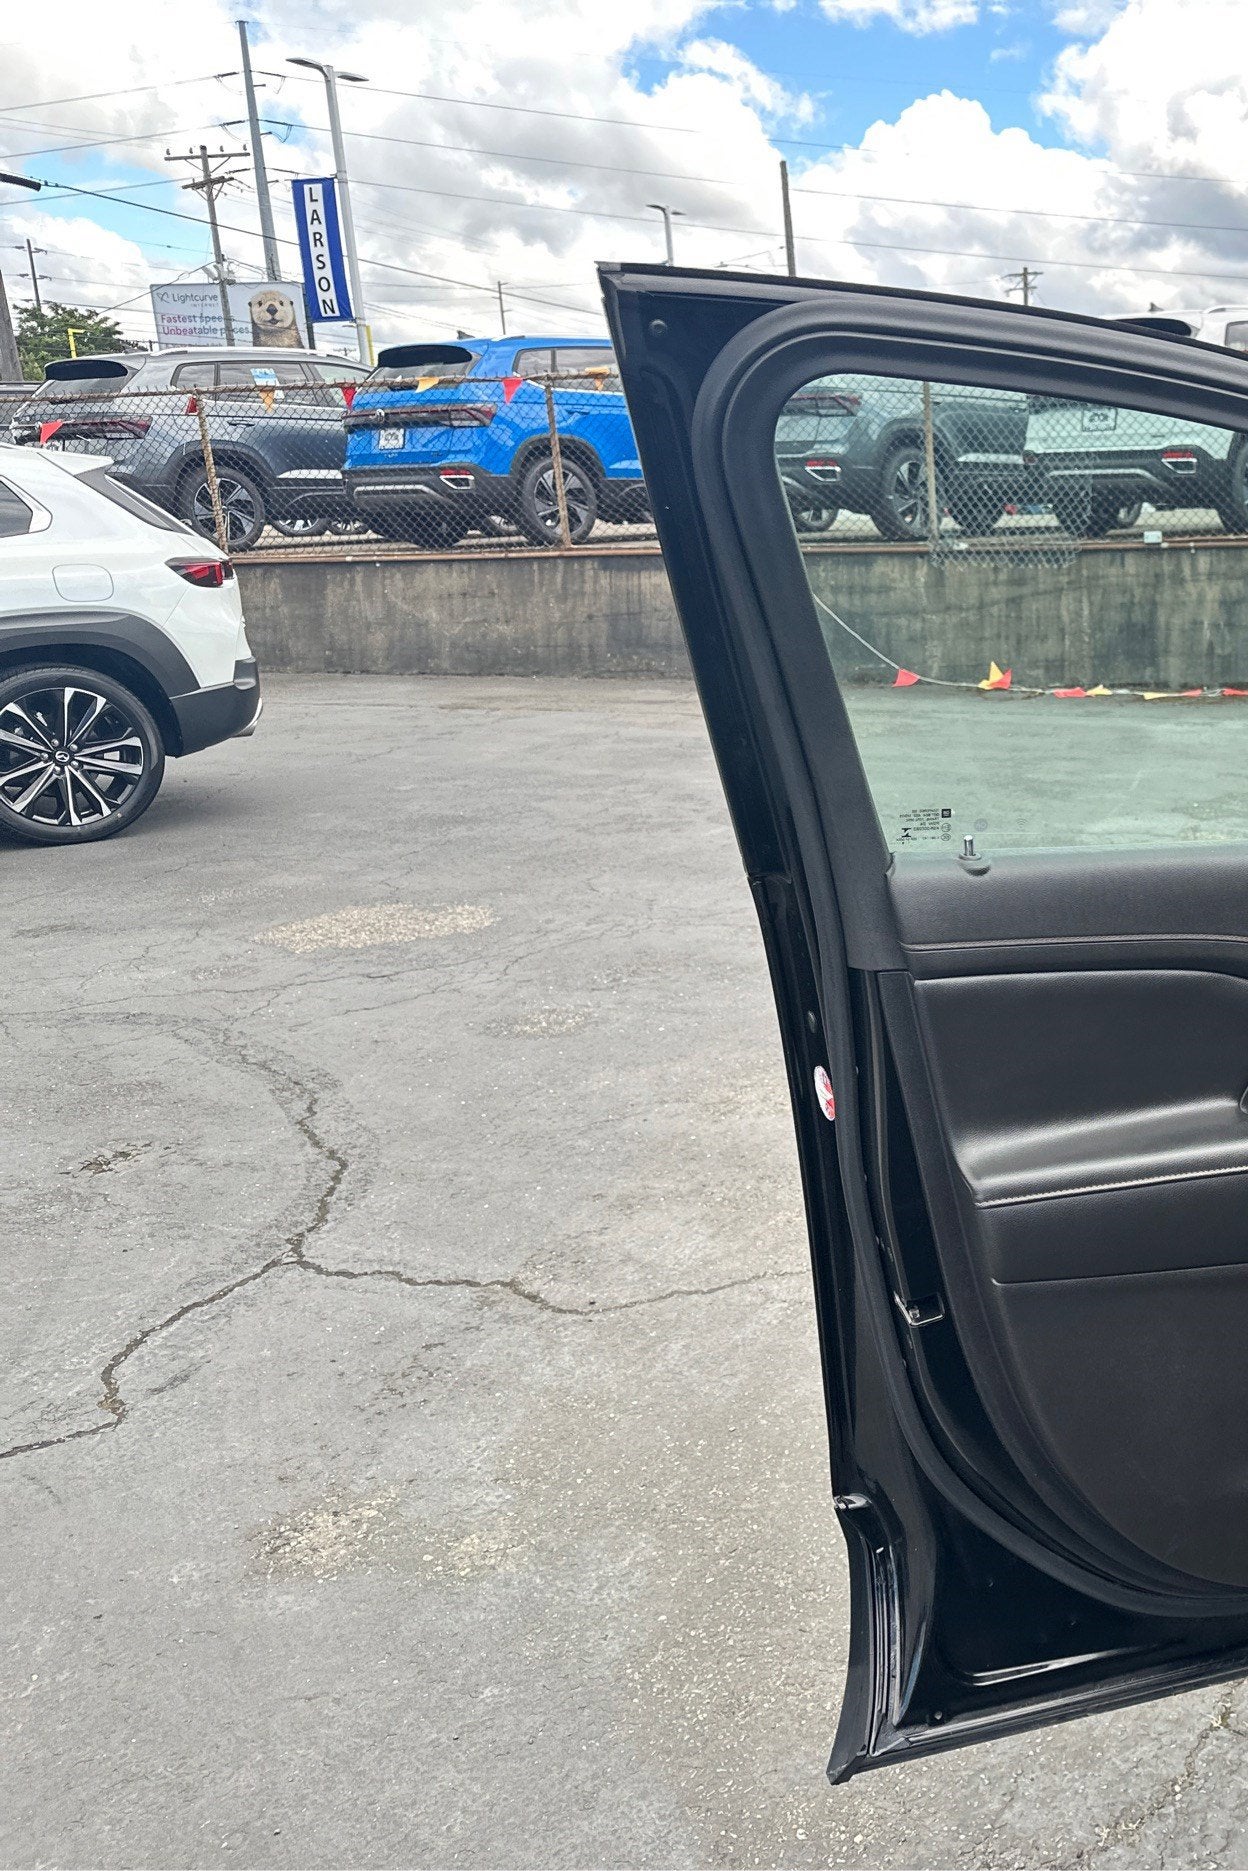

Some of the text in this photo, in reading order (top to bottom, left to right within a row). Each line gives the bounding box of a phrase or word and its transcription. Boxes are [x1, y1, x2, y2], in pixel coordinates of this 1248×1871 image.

[309, 187, 336, 316] LARSON
[172, 292, 218, 304] Lightcurve
[161, 314, 197, 323] Fastest
[163, 326, 250, 338] Unbeatable pces
